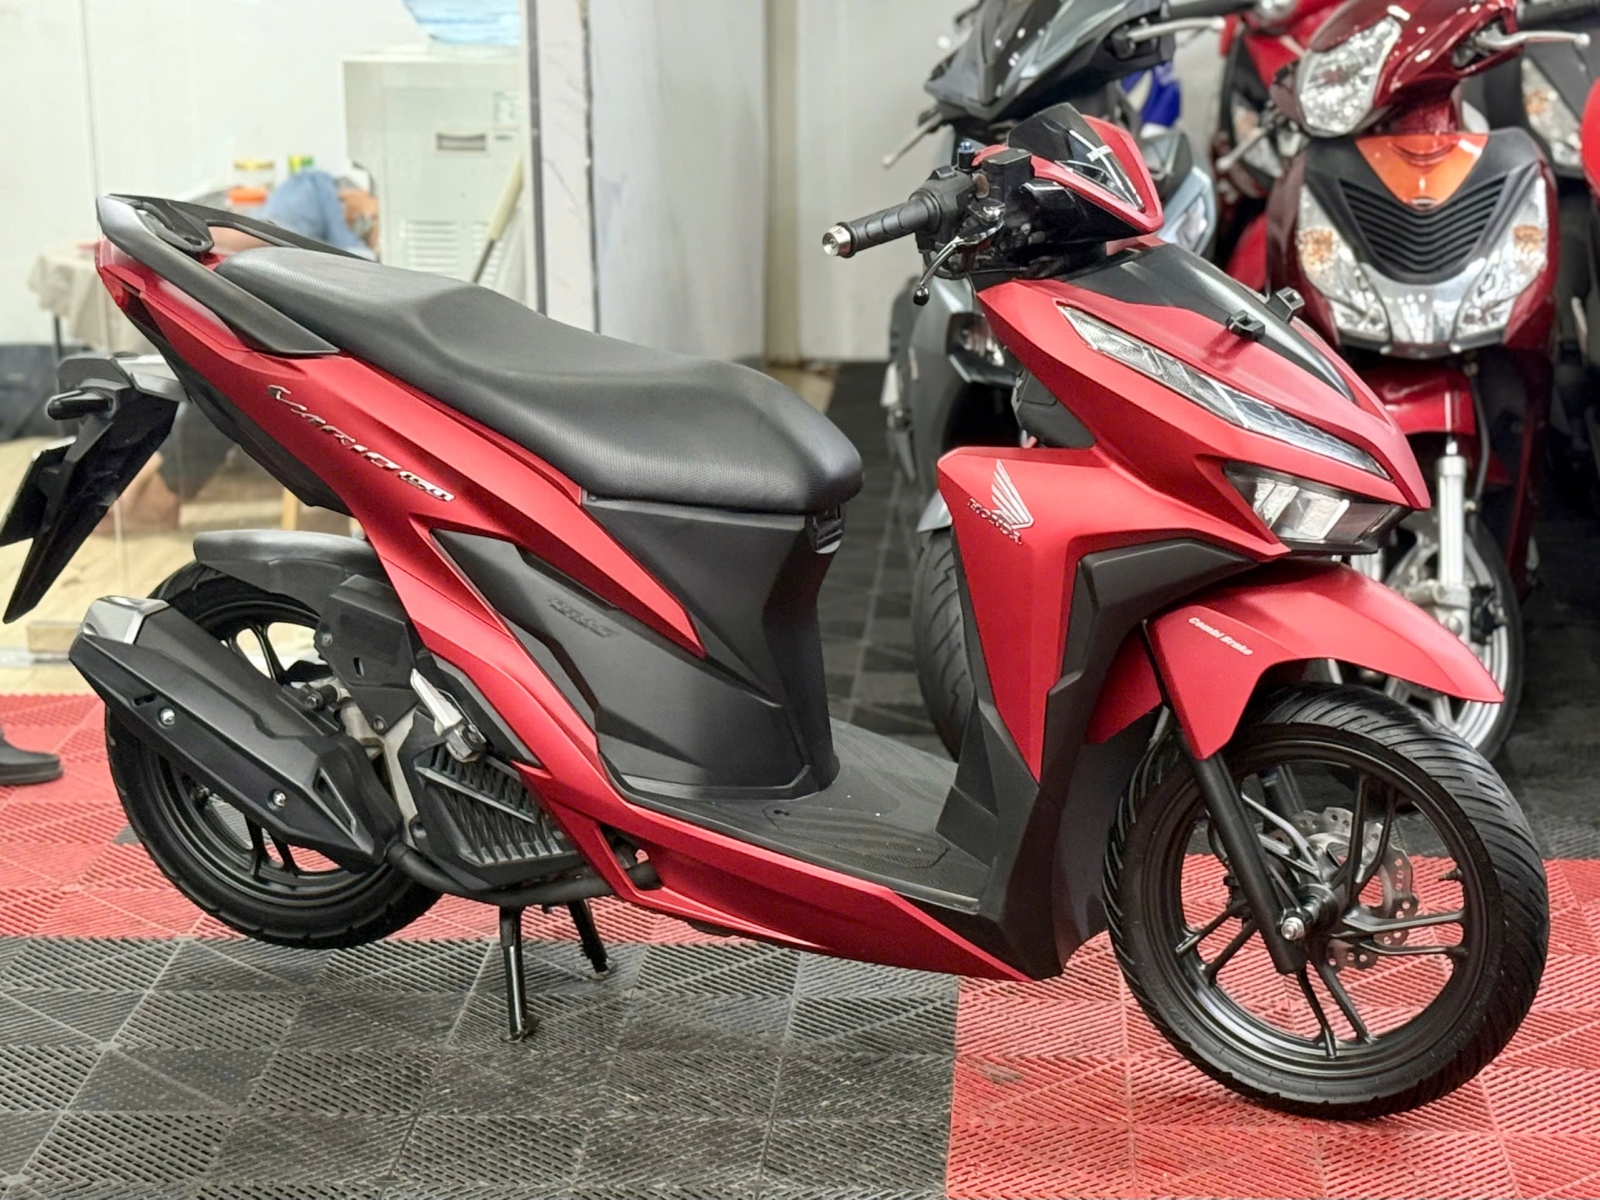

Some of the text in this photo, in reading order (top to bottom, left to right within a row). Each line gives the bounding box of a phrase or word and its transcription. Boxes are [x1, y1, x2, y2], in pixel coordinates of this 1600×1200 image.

[398, 470, 455, 502] 150
[967, 498, 1023, 545] HONDA
[1188, 617, 1254, 656] Combi Brake
